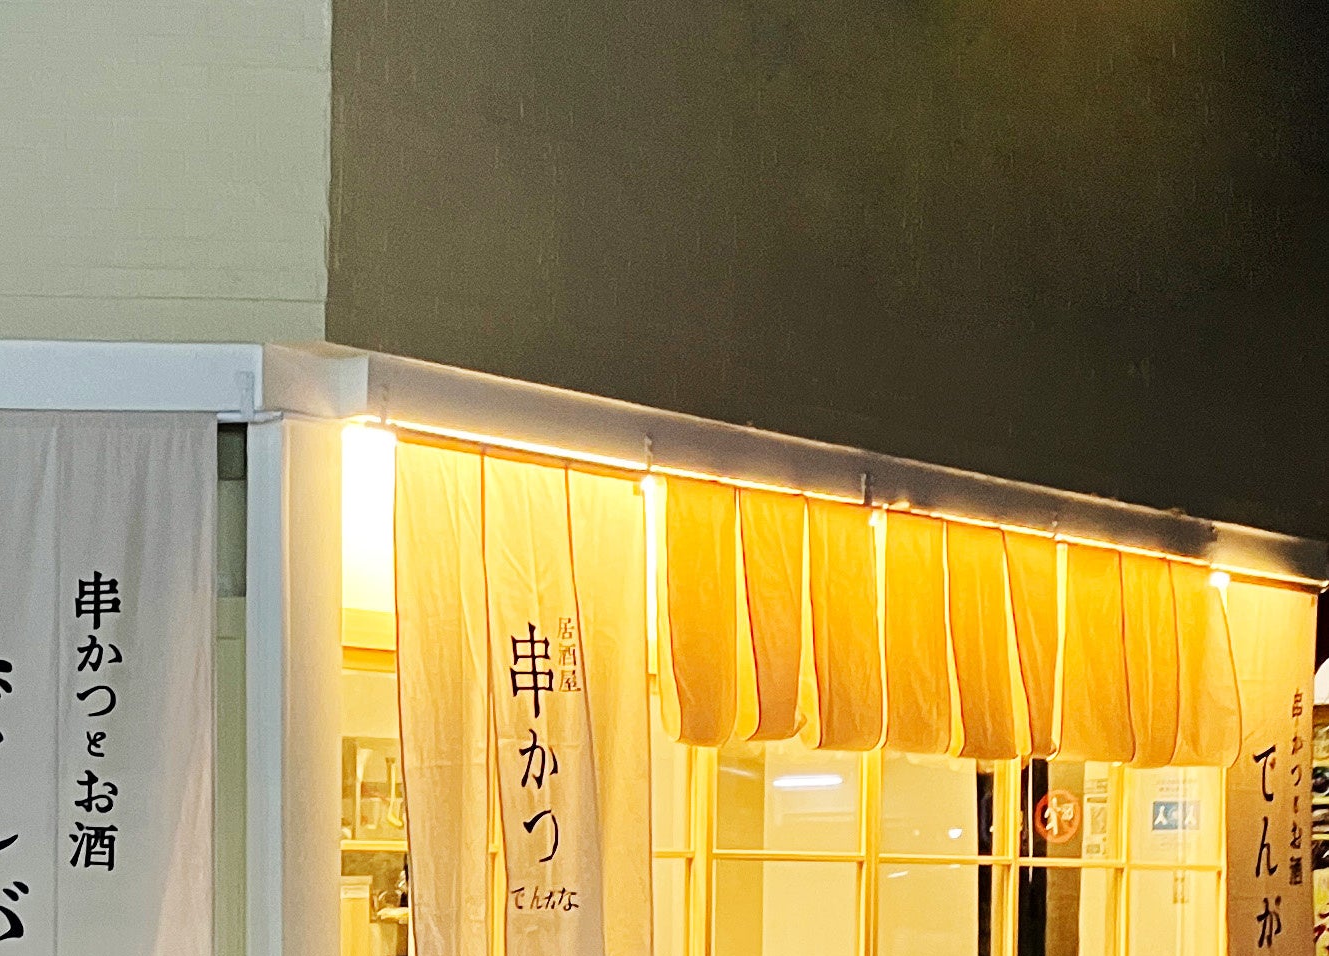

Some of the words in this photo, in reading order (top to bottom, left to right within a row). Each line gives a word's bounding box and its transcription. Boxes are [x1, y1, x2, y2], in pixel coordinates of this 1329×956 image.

[68, 568, 124, 872] 串かつとお酒
[509, 622, 560, 863] 串かつ
[557, 616, 581, 693] 居酒屋
